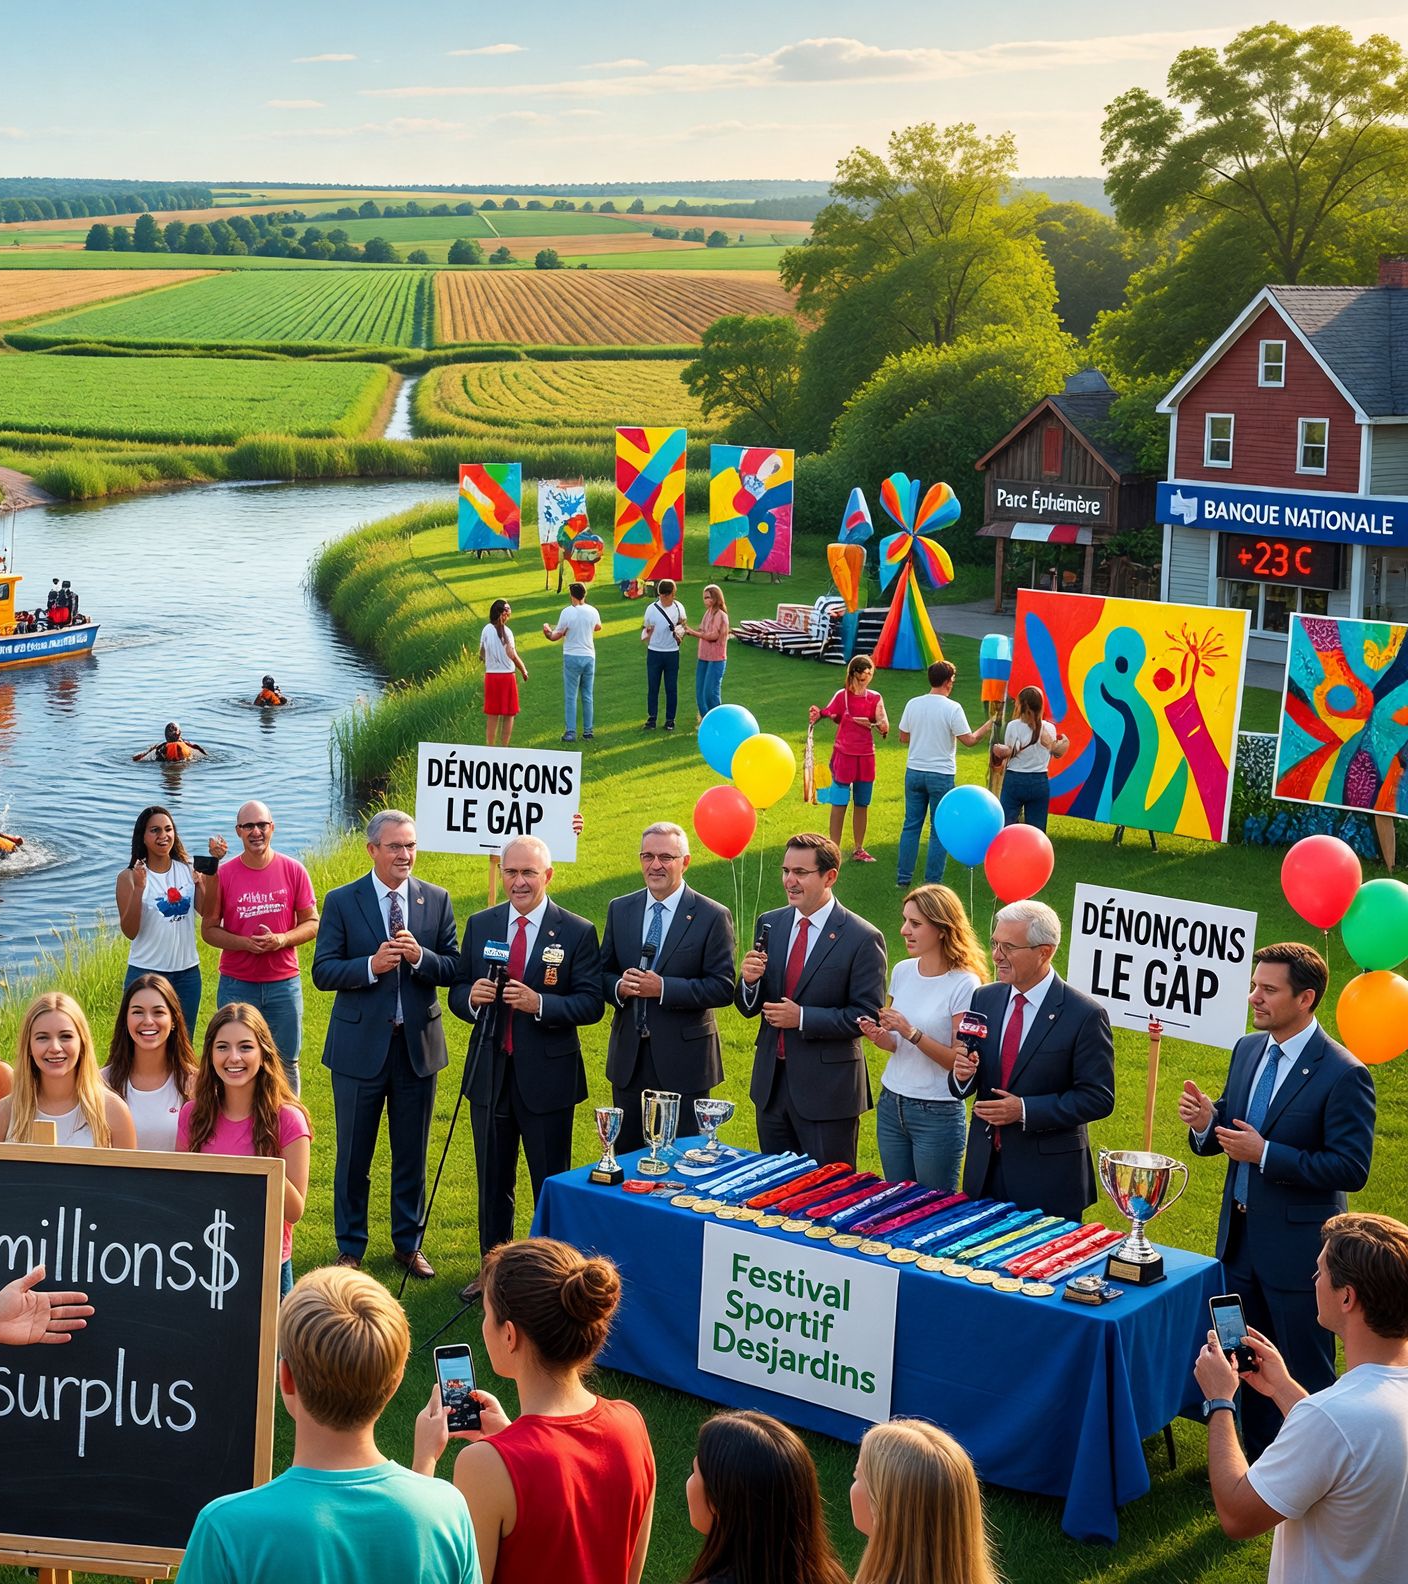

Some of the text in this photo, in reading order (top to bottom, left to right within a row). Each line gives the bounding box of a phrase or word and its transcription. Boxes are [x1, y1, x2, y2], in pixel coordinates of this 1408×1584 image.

[997, 488, 1028, 508] Parc
[1204, 500, 1395, 535] BANQUE NATIONALE
[1237, 541, 1312, 577] +23 C
[427, 750, 573, 798] DÉNONÇONS
[446, 797, 478, 833] LE
[1081, 898, 1246, 964] DÉNONÇONS
[1091, 949, 1219, 1017] LE GAP
[732, 1252, 851, 1312] Festival
[725, 1289, 835, 1343] Sportif
[712, 1321, 876, 1394] Desjardins
